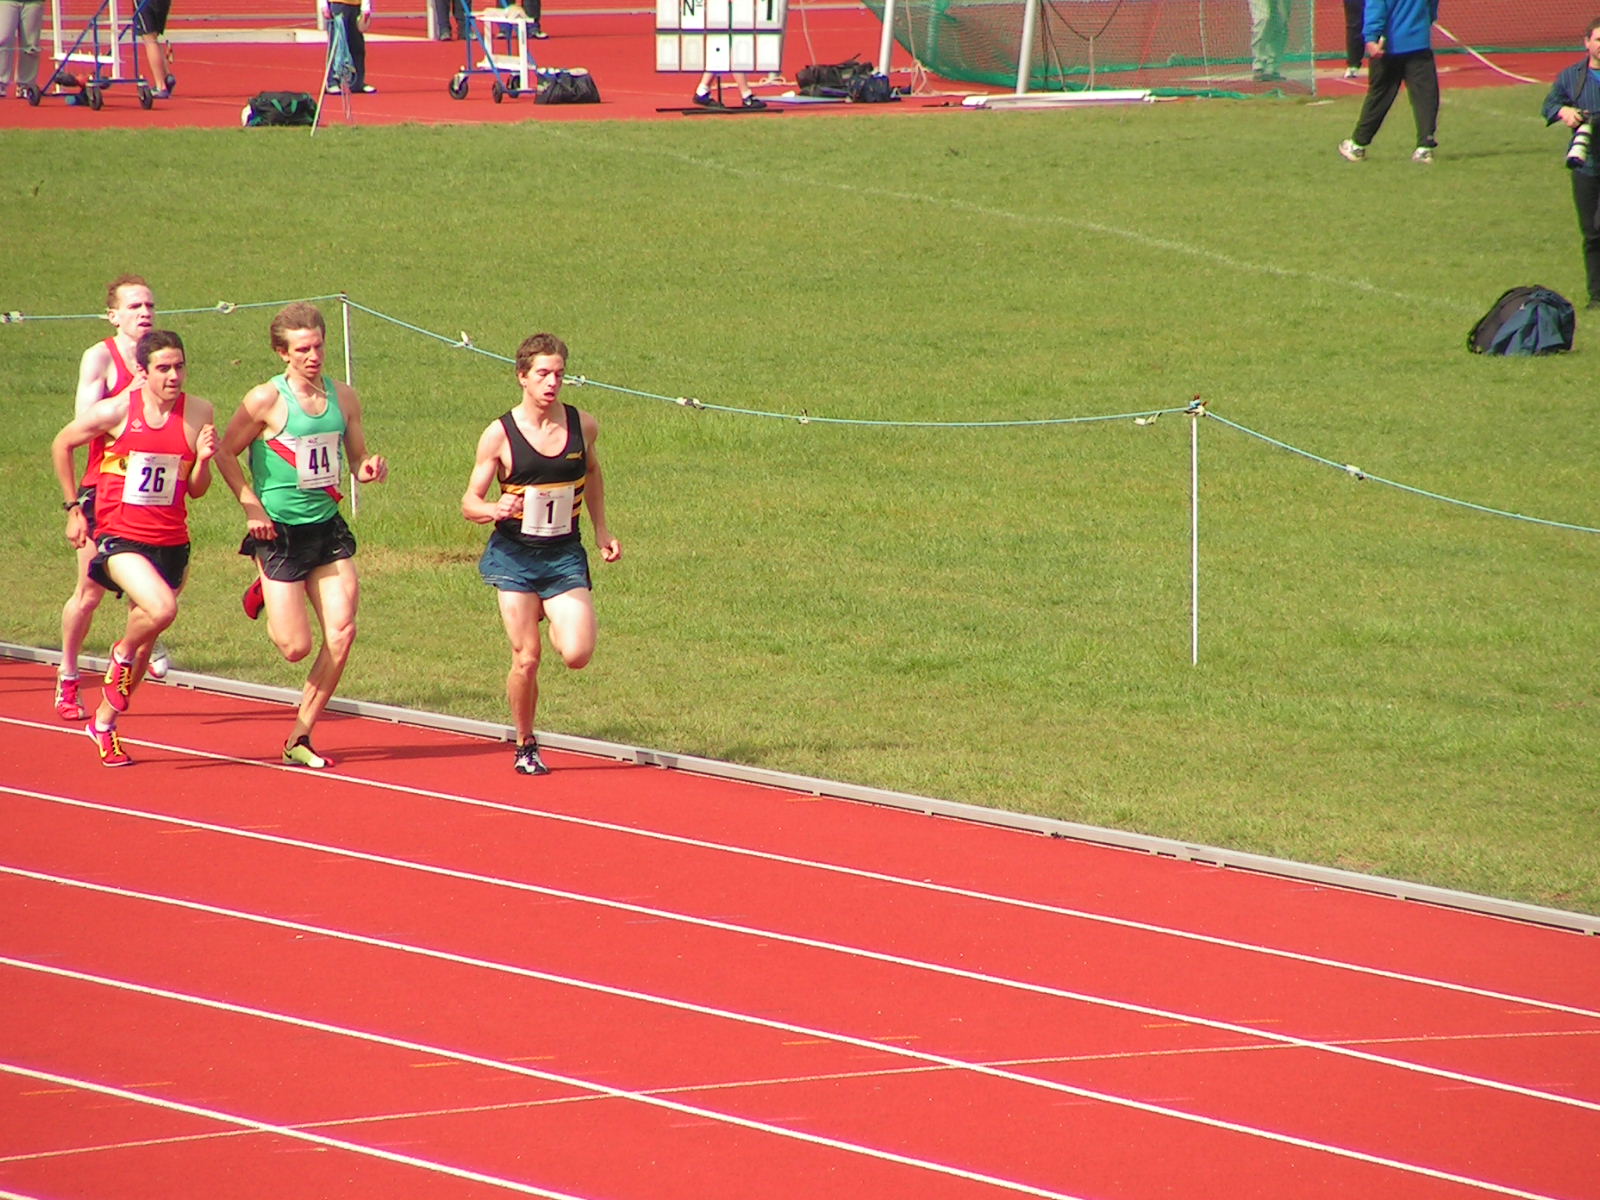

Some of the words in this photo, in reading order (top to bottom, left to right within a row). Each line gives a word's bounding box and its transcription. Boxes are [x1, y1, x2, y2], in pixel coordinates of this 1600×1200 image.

[309, 446, 330, 475] 44
[138, 466, 166, 493] 26
[545, 500, 554, 524] 1
